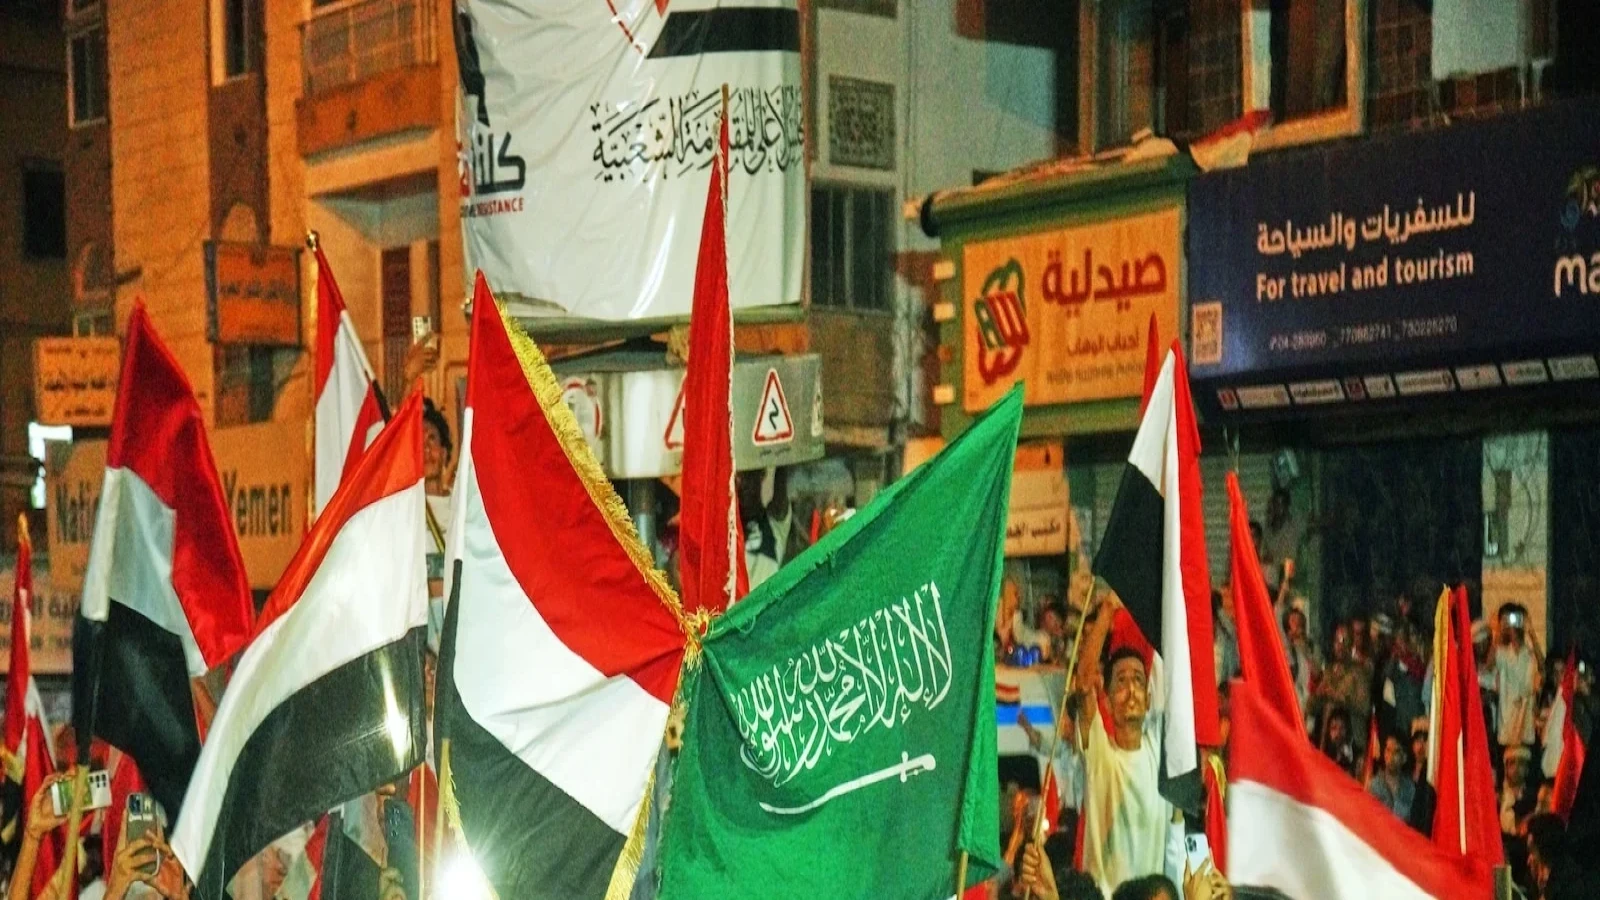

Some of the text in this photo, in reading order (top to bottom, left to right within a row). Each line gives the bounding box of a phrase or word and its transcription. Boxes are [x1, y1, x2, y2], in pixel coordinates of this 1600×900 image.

[1256, 190, 1475, 258] للسفريات والسياحة
[1042, 248, 1168, 318] صيدلية
[1256, 248, 1474, 302] For travel and tourism
[222, 468, 293, 537] Yemen
